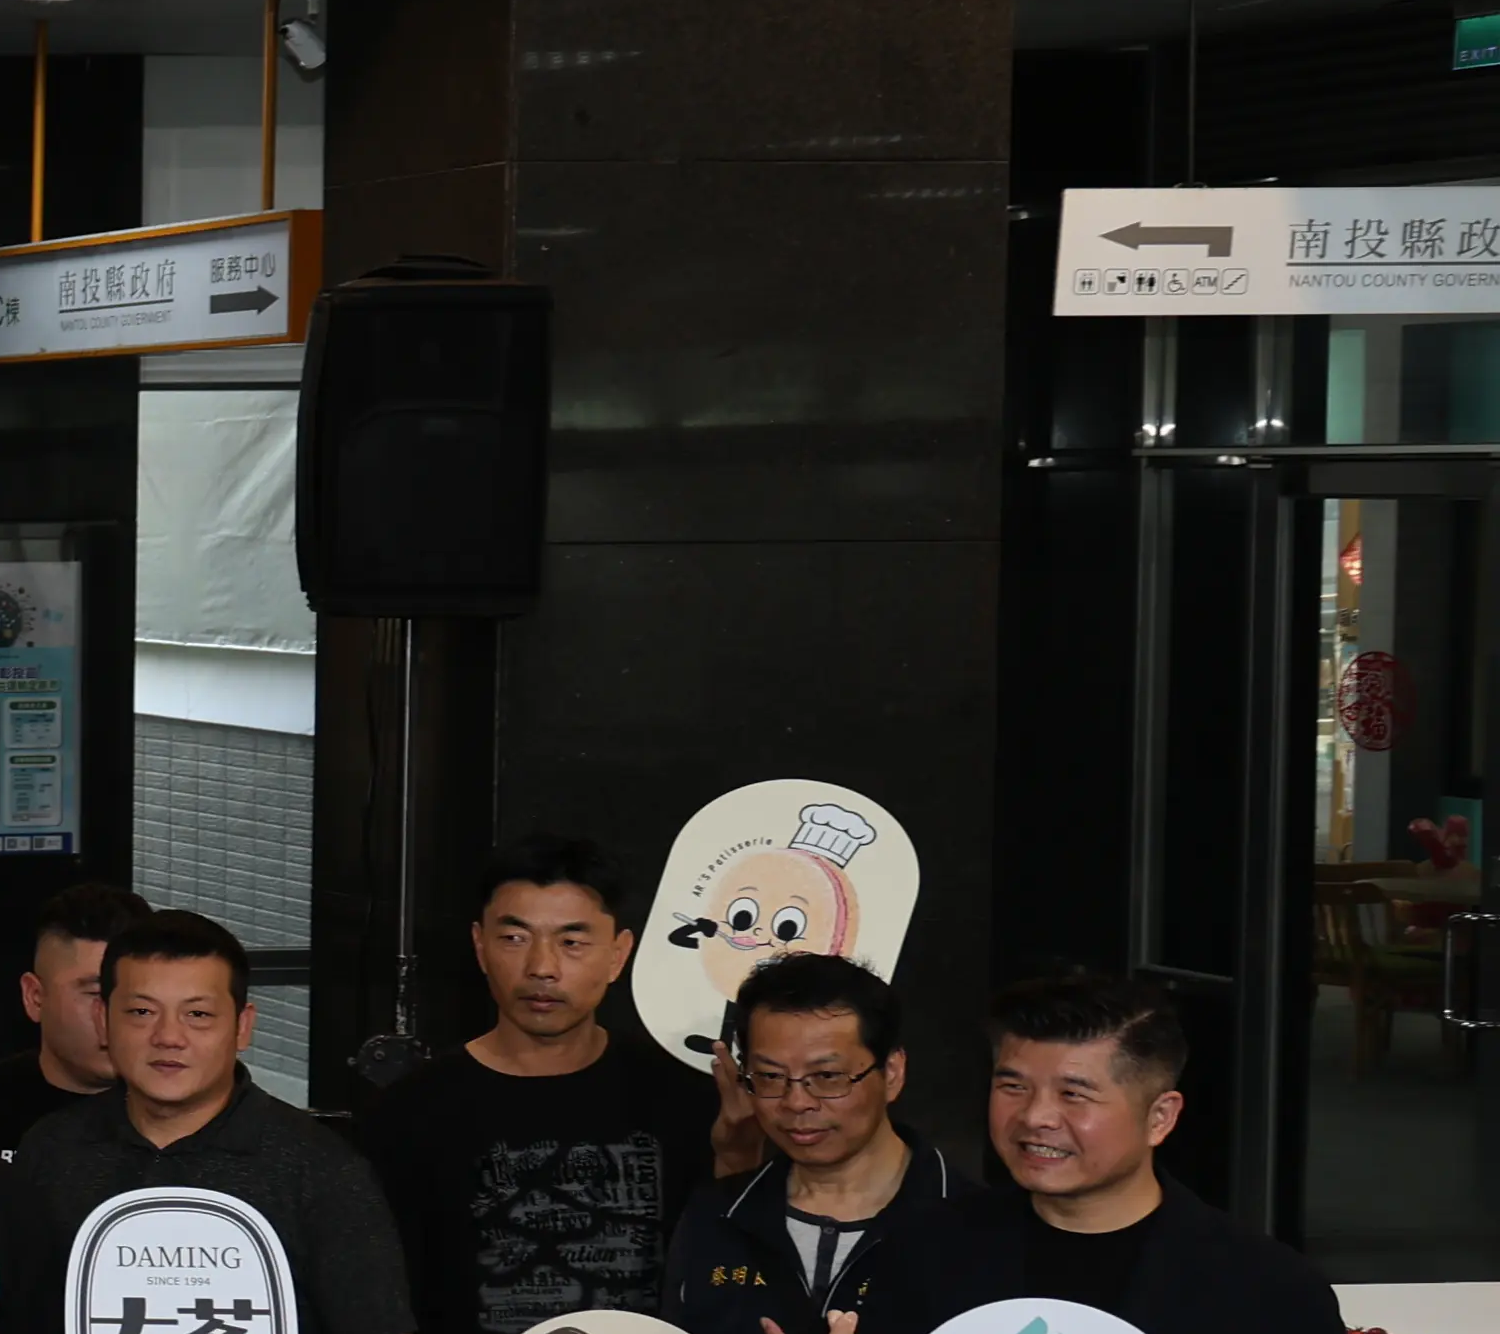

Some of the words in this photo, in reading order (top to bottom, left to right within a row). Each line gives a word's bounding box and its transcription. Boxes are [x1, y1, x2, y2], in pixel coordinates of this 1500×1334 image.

[1459, 46, 1497, 62] EXIT
[210, 253, 277, 284] 服務中心
[58, 259, 177, 307] 南投縣政府
[1194, 275, 1218, 288] ATM
[1288, 274, 1356, 288] NANTOU
[1361, 274, 1428, 288] COUNTY
[60, 318, 88, 331] NANTOU
[90, 315, 118, 329] COUNTY
[121, 309, 173, 327] GOVERNMENT
[116, 1245, 242, 1269] DAMING
[146, 1276, 180, 1286] SINCE
[184, 1276, 211, 1286] 1994
